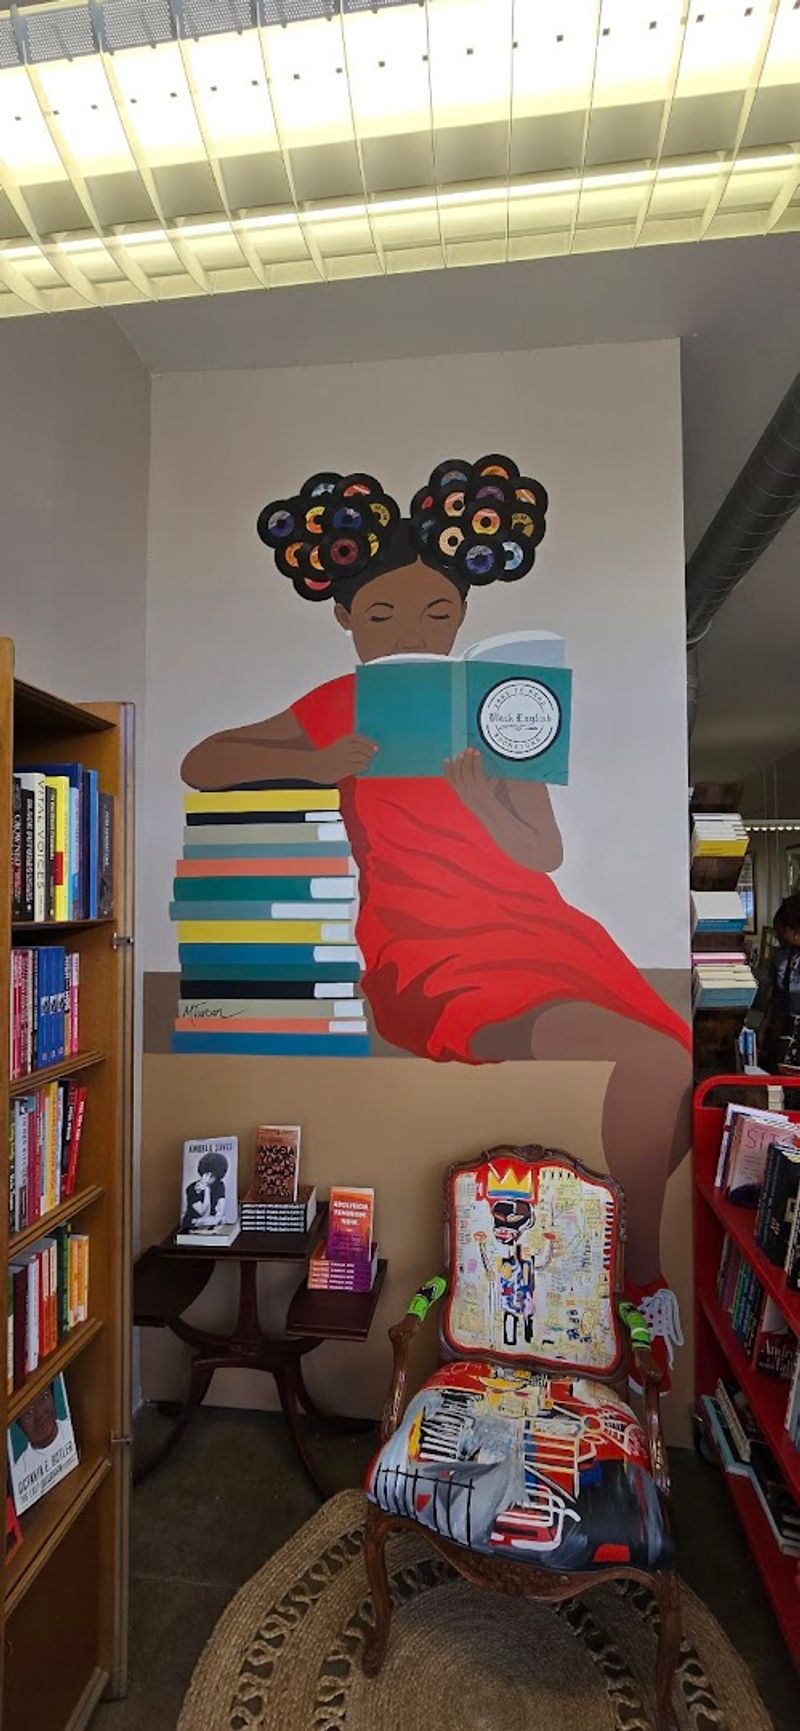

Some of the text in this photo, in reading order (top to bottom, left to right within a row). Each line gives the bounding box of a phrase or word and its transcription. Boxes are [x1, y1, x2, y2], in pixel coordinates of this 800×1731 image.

[489, 712, 552, 725] Black English
[36, 780, 46, 890] VITAL VOICES
[188, 1143, 213, 1153] ANGELA
[257, 1145, 295, 1156] ANGELA
[17, 1468, 44, 1496] OCTAVIA
